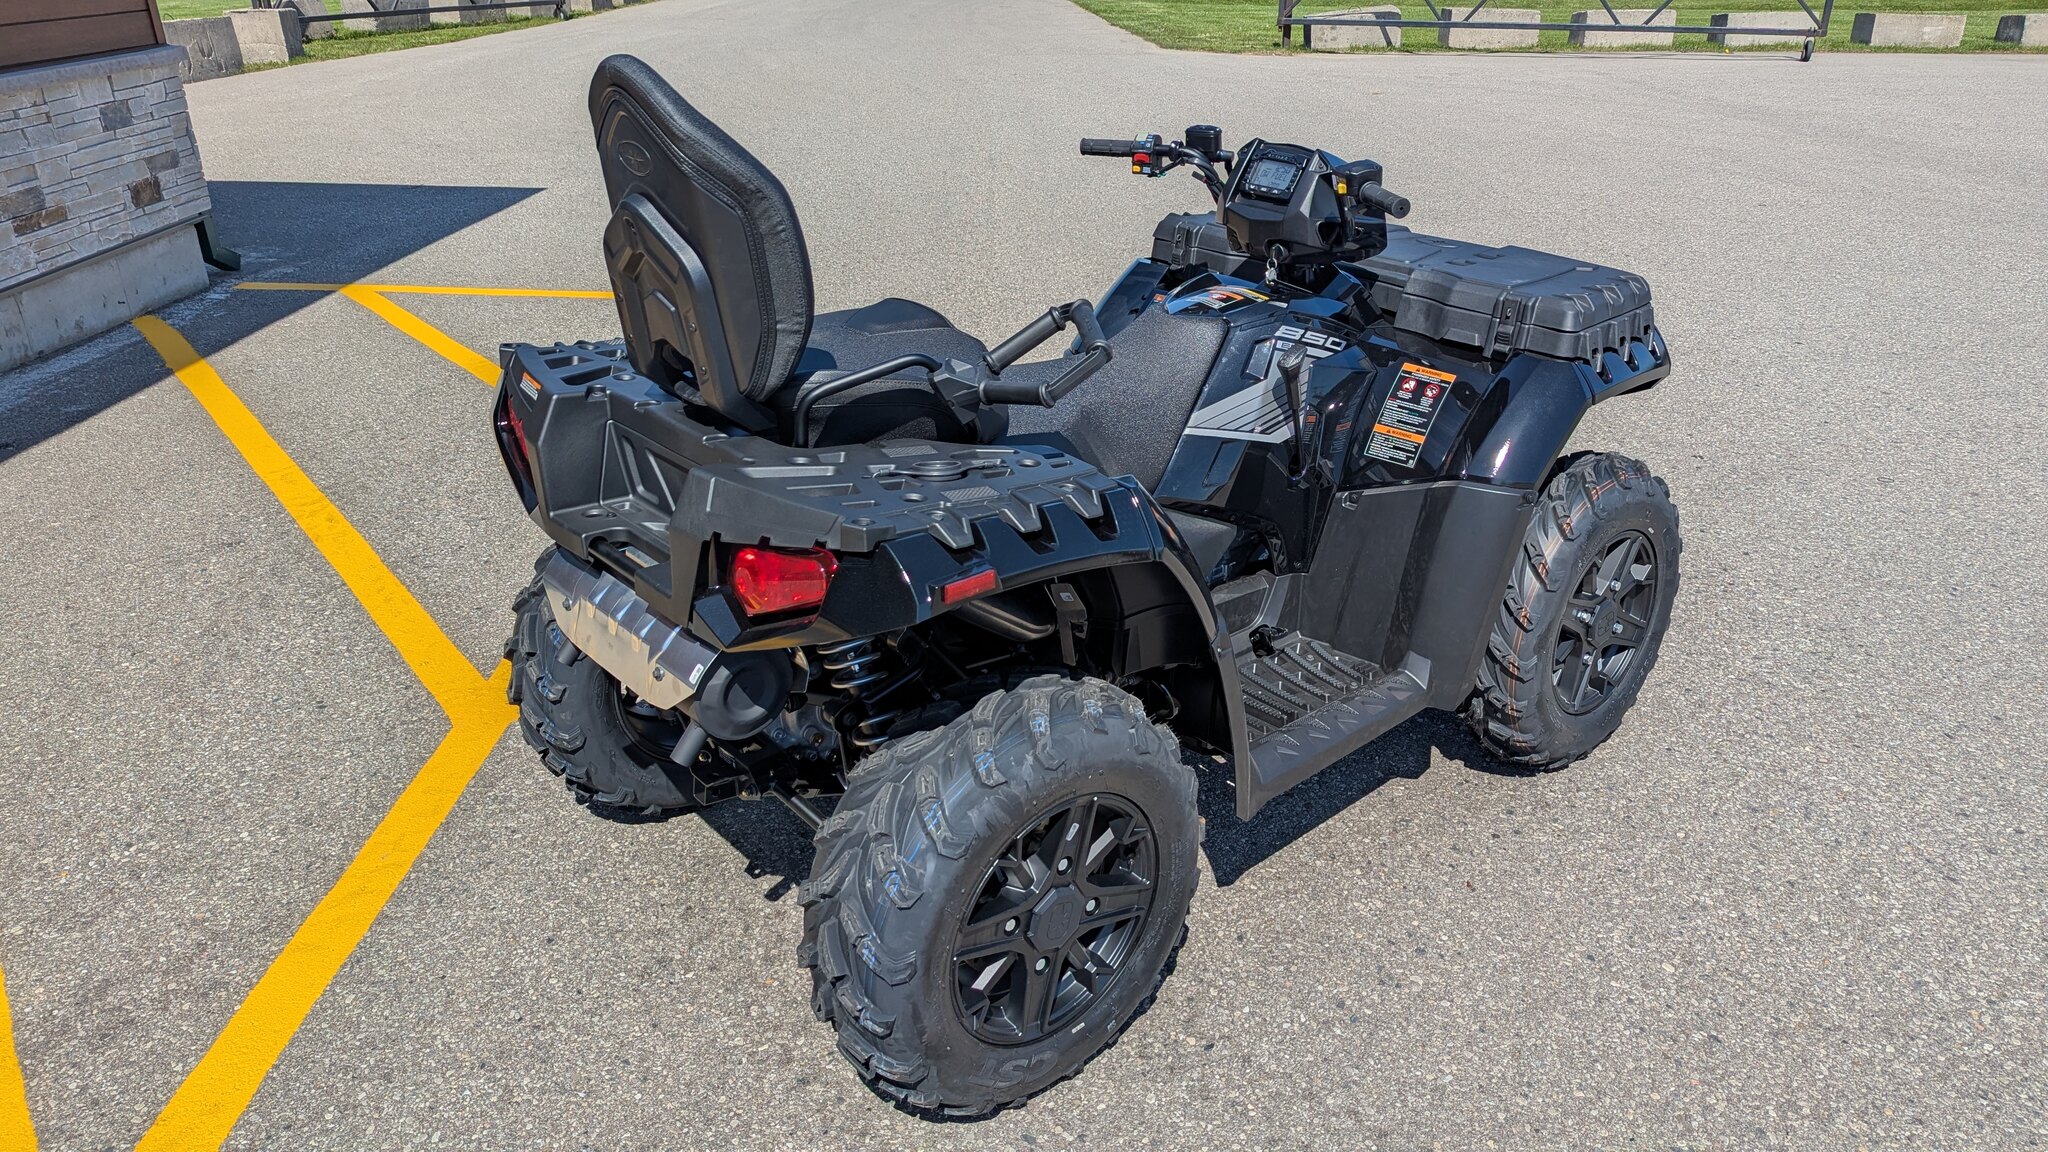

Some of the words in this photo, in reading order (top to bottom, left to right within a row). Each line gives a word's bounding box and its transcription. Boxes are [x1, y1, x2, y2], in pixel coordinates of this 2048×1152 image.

[1274, 325, 1347, 351] 850
[1391, 430, 1413, 440] WARNING
[967, 1050, 1059, 1089] CST
